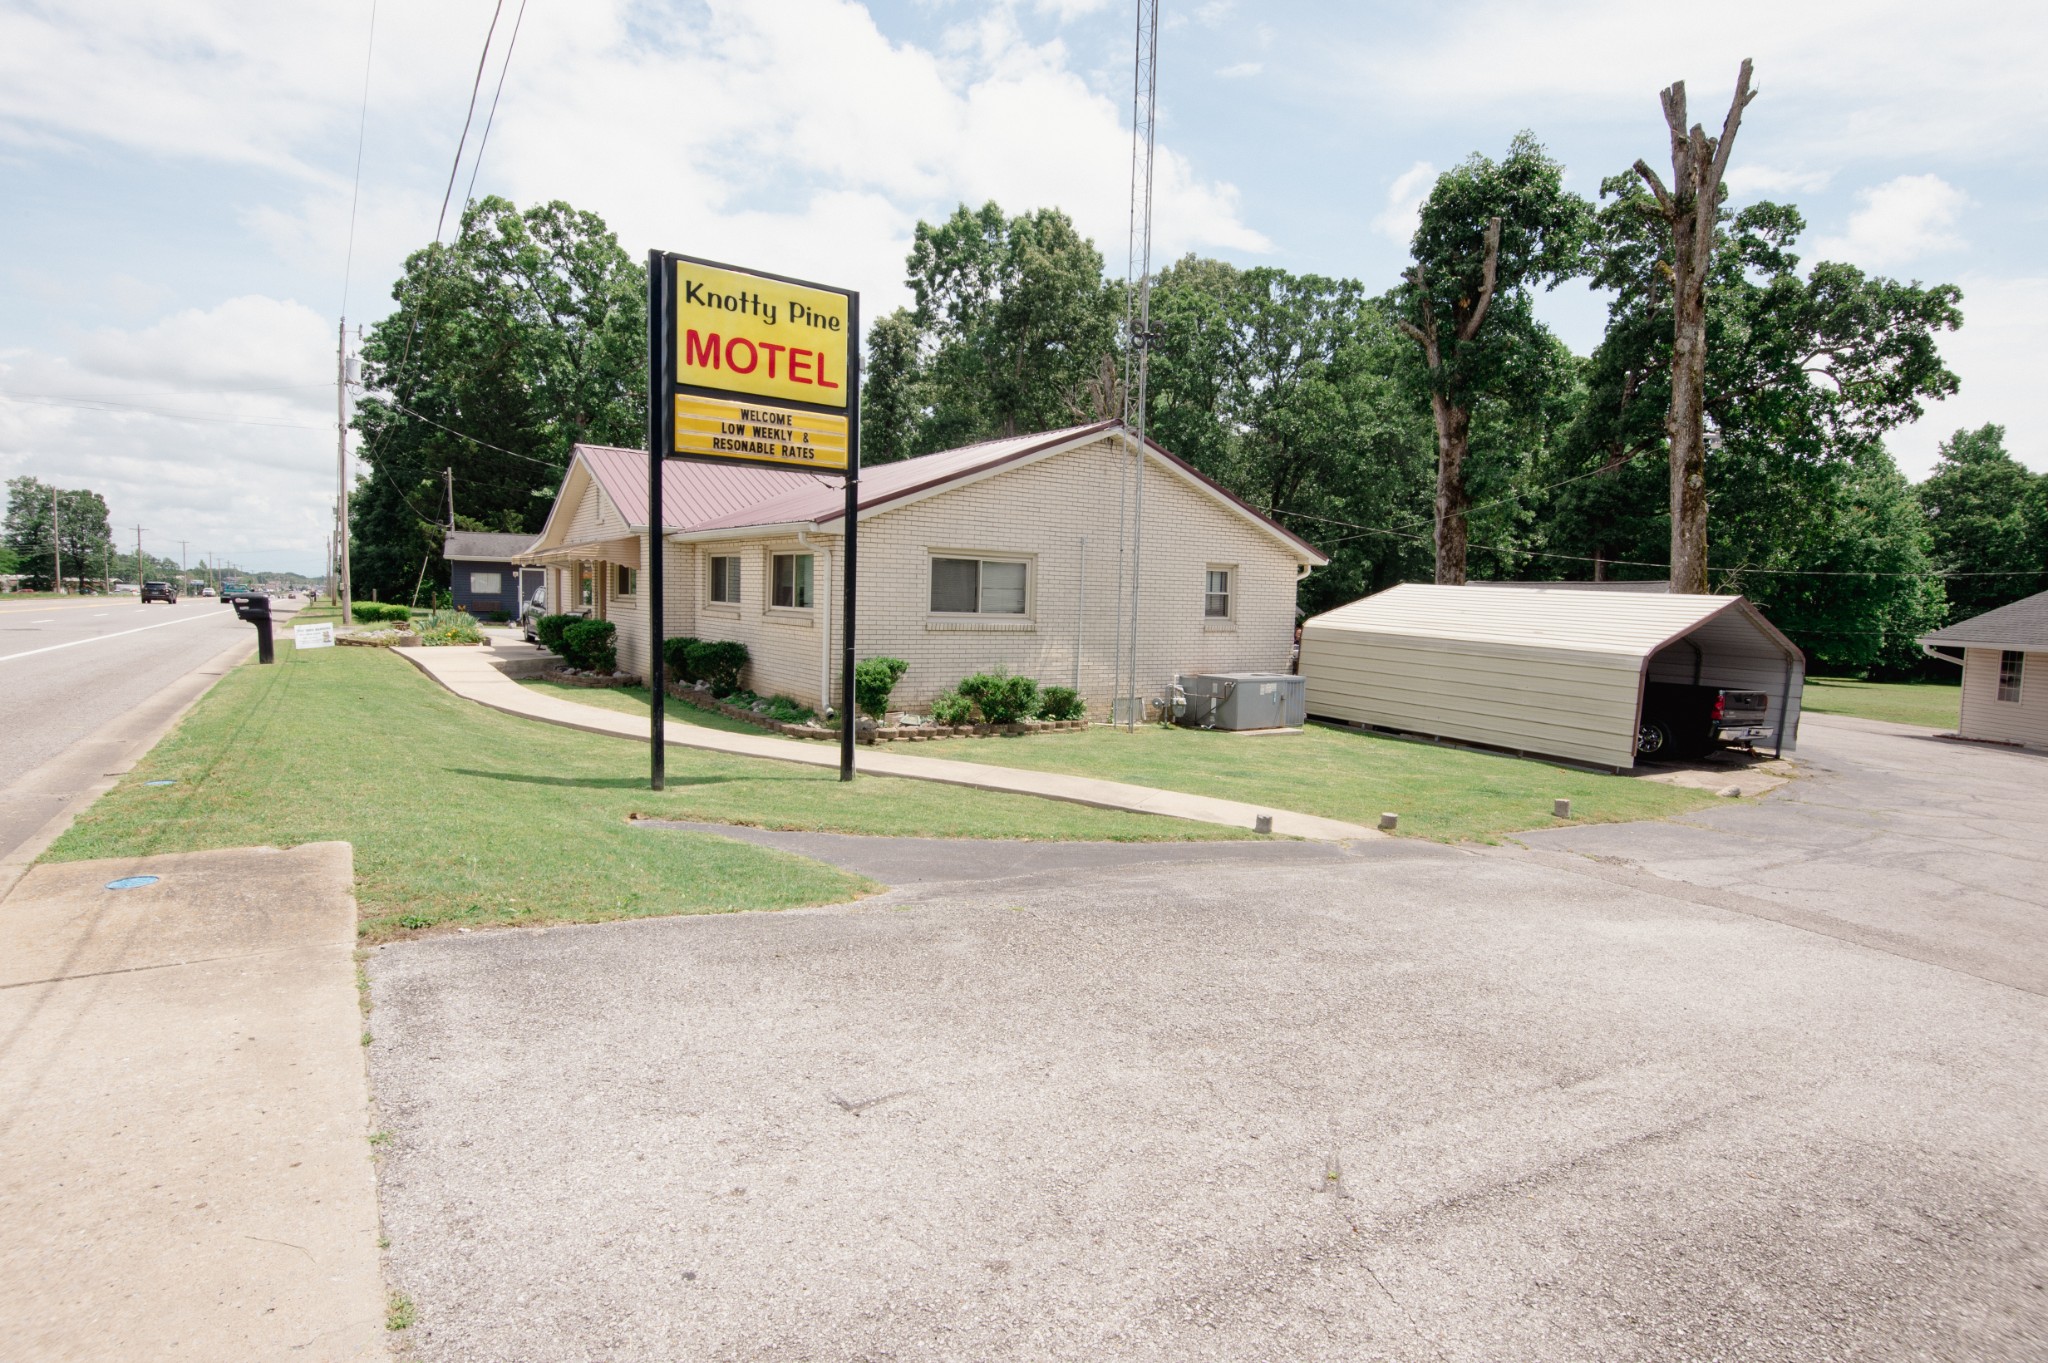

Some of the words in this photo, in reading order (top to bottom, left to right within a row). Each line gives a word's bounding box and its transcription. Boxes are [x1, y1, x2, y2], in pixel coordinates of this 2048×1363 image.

[685, 280, 777, 325] Knotty
[789, 301, 841, 332] Pine
[686, 329, 839, 389] MOTEL
[740, 409, 793, 426] WELCOME
[721, 422, 745, 436] LOW
[752, 426, 793, 441] WEEKLY
[803, 432, 809, 443] &
[713, 437, 775, 455] RESONABLE
[781, 445, 815, 459] RATES
